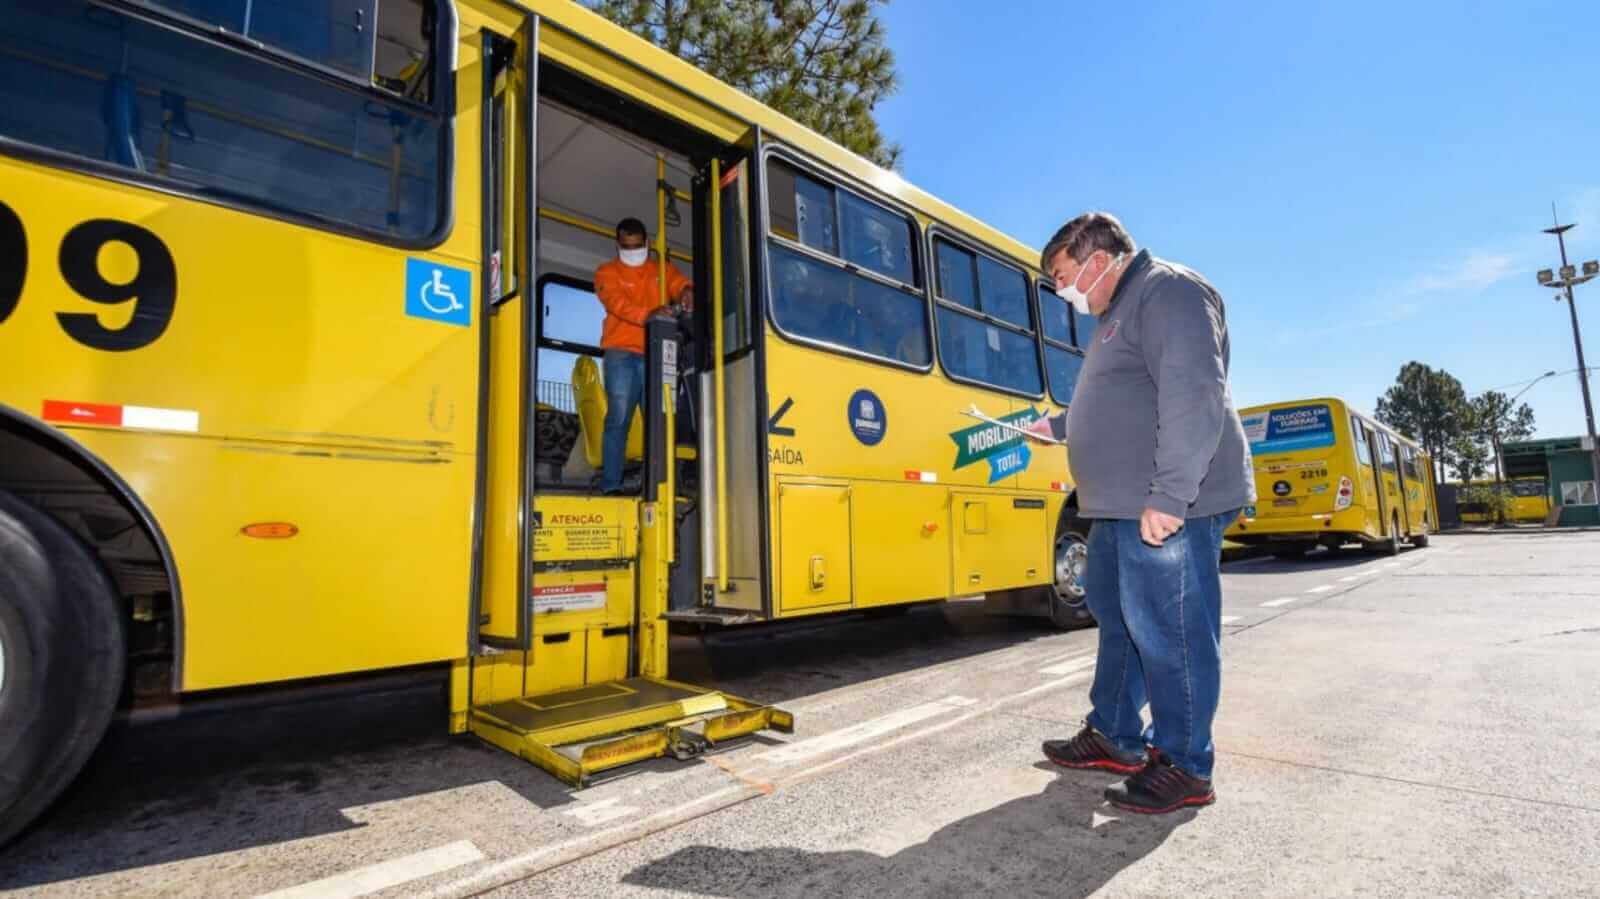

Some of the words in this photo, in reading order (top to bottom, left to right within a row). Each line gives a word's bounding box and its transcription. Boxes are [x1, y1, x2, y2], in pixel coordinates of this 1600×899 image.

[0, 203, 177, 352] 9
[997, 451, 1023, 473] TOTAL
[551, 513, 604, 525] ATENÇÃO
